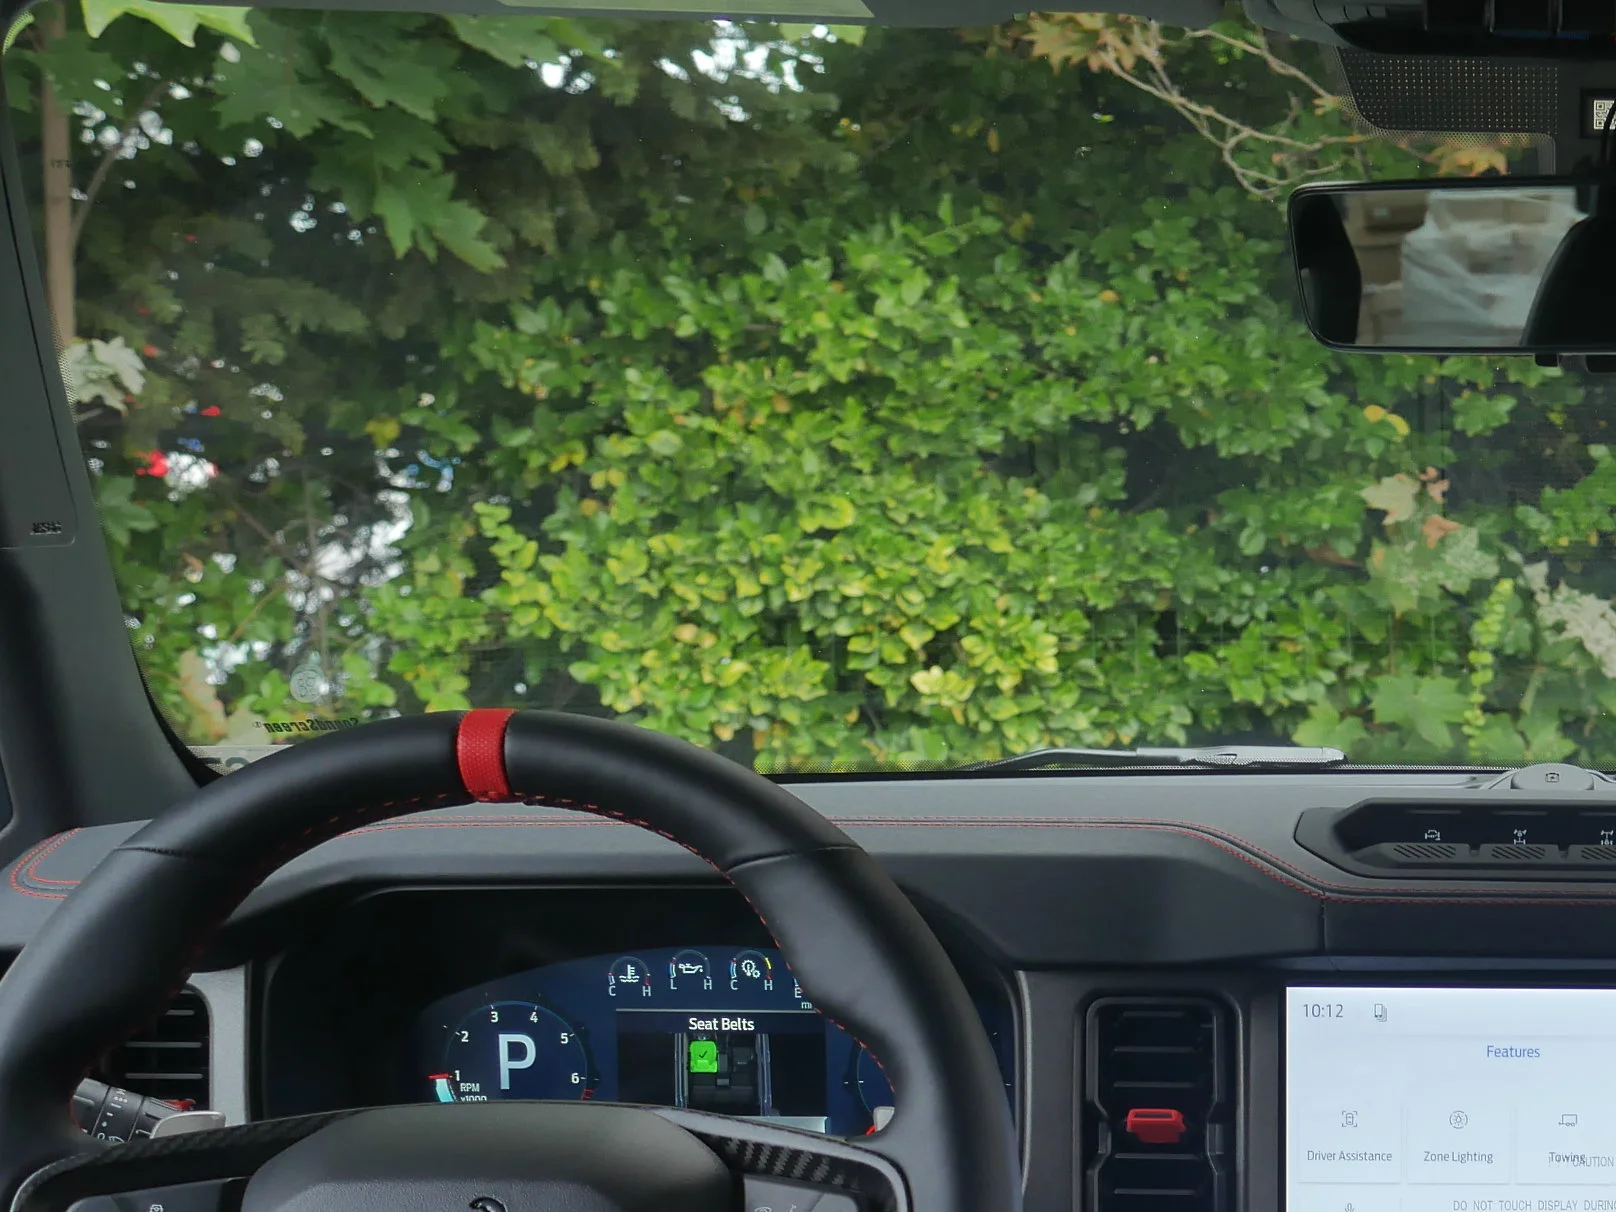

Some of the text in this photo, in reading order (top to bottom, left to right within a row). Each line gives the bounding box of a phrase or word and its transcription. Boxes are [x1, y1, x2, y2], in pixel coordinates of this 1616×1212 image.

[608, 985, 616, 996] C
[642, 985, 651, 996] H
[670, 979, 677, 990] L
[703, 979, 712, 990] H
[730, 979, 738, 990] C
[764, 979, 773, 990] H
[1303, 1003, 1344, 1018] 10:12
[490, 1011, 499, 1023] 3
[529, 1011, 538, 1023] 4
[688, 1017, 755, 1031] Seat Belts
[460, 1031, 469, 1043] 2
[560, 1032, 569, 1044] 5
[1486, 1045, 1541, 1058] Features
[498, 1033, 537, 1090] P
[454, 1070, 461, 1082] 1
[571, 1073, 580, 1084] 6
[460, 1082, 480, 1092] RPM
[1307, 1150, 1393, 1161] Driver Assistance
[1423, 1150, 1494, 1164] Zone Lighting
[1549, 1151, 1586, 1164] Towing
[1453, 1200, 1467, 1211] DO
[1473, 1200, 1493, 1211] NOT
[1498, 1200, 1532, 1211] TOUCH
[1537, 1200, 1578, 1211] DISPLAY
